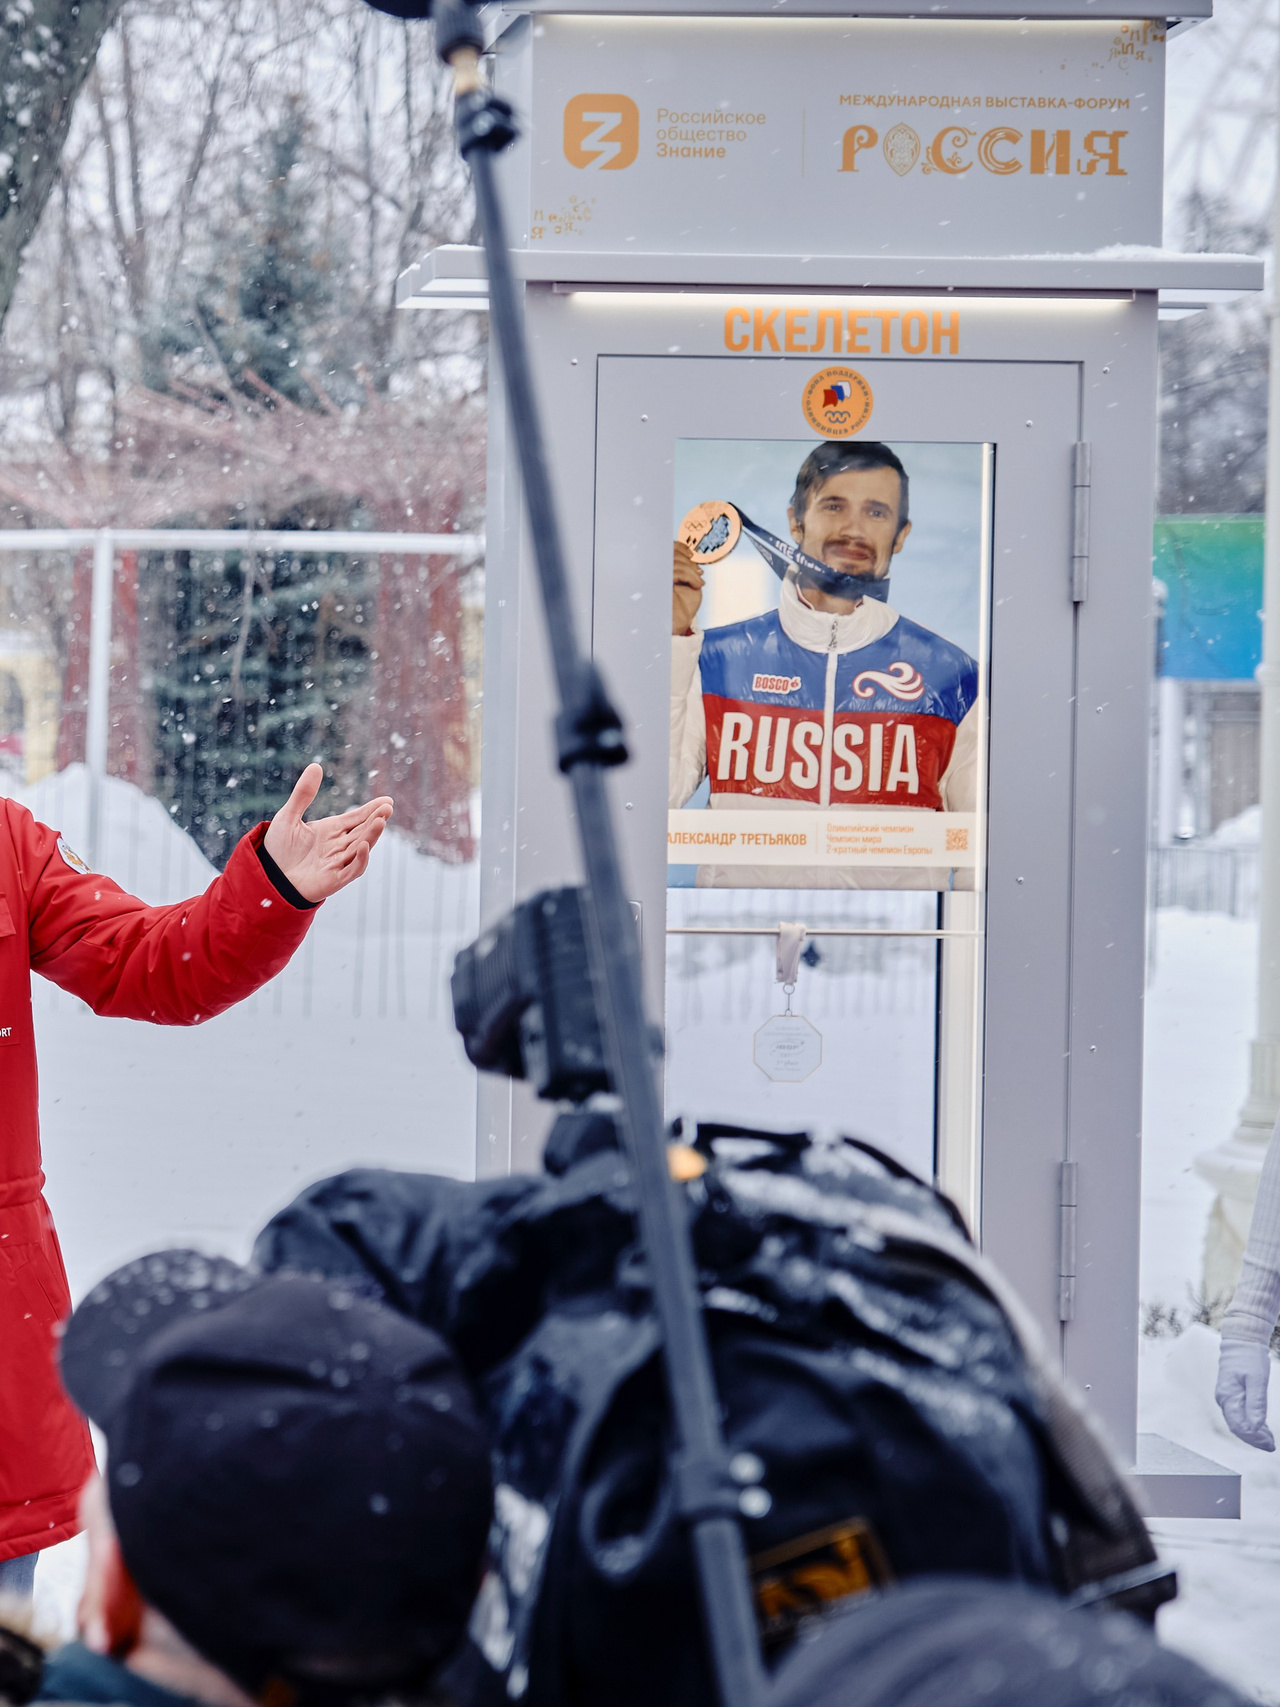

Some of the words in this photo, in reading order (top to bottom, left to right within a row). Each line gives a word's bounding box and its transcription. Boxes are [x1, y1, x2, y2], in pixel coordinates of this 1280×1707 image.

[839, 94, 981, 109] МЕЖДУНАРОДНАЯ
[985, 96, 1130, 110] ВЫСТАВКА-ФОРУМ
[657, 108, 767, 125] Российское
[656, 126, 747, 143] общество
[656, 142, 727, 158] Знание
[836, 122, 1129, 177] РОССИЯ
[723, 306, 960, 355] СКЕЛЕТОН
[754, 675, 790, 692] BOSCO
[717, 711, 920, 795] RUSSIA
[826, 822, 880, 833] Олимпийский
[880, 824, 915, 834] чемпион
[666, 831, 737, 846] АЛЕКСАНДР
[739, 832, 807, 846] ТРЕТЬЯКОВ
[826, 834, 861, 843] Чемпион
[861, 835, 882, 844] мира
[826, 844, 868, 855] 2-кратный
[868, 846, 903, 855] чемпион
[903, 845, 933, 856] Европы
